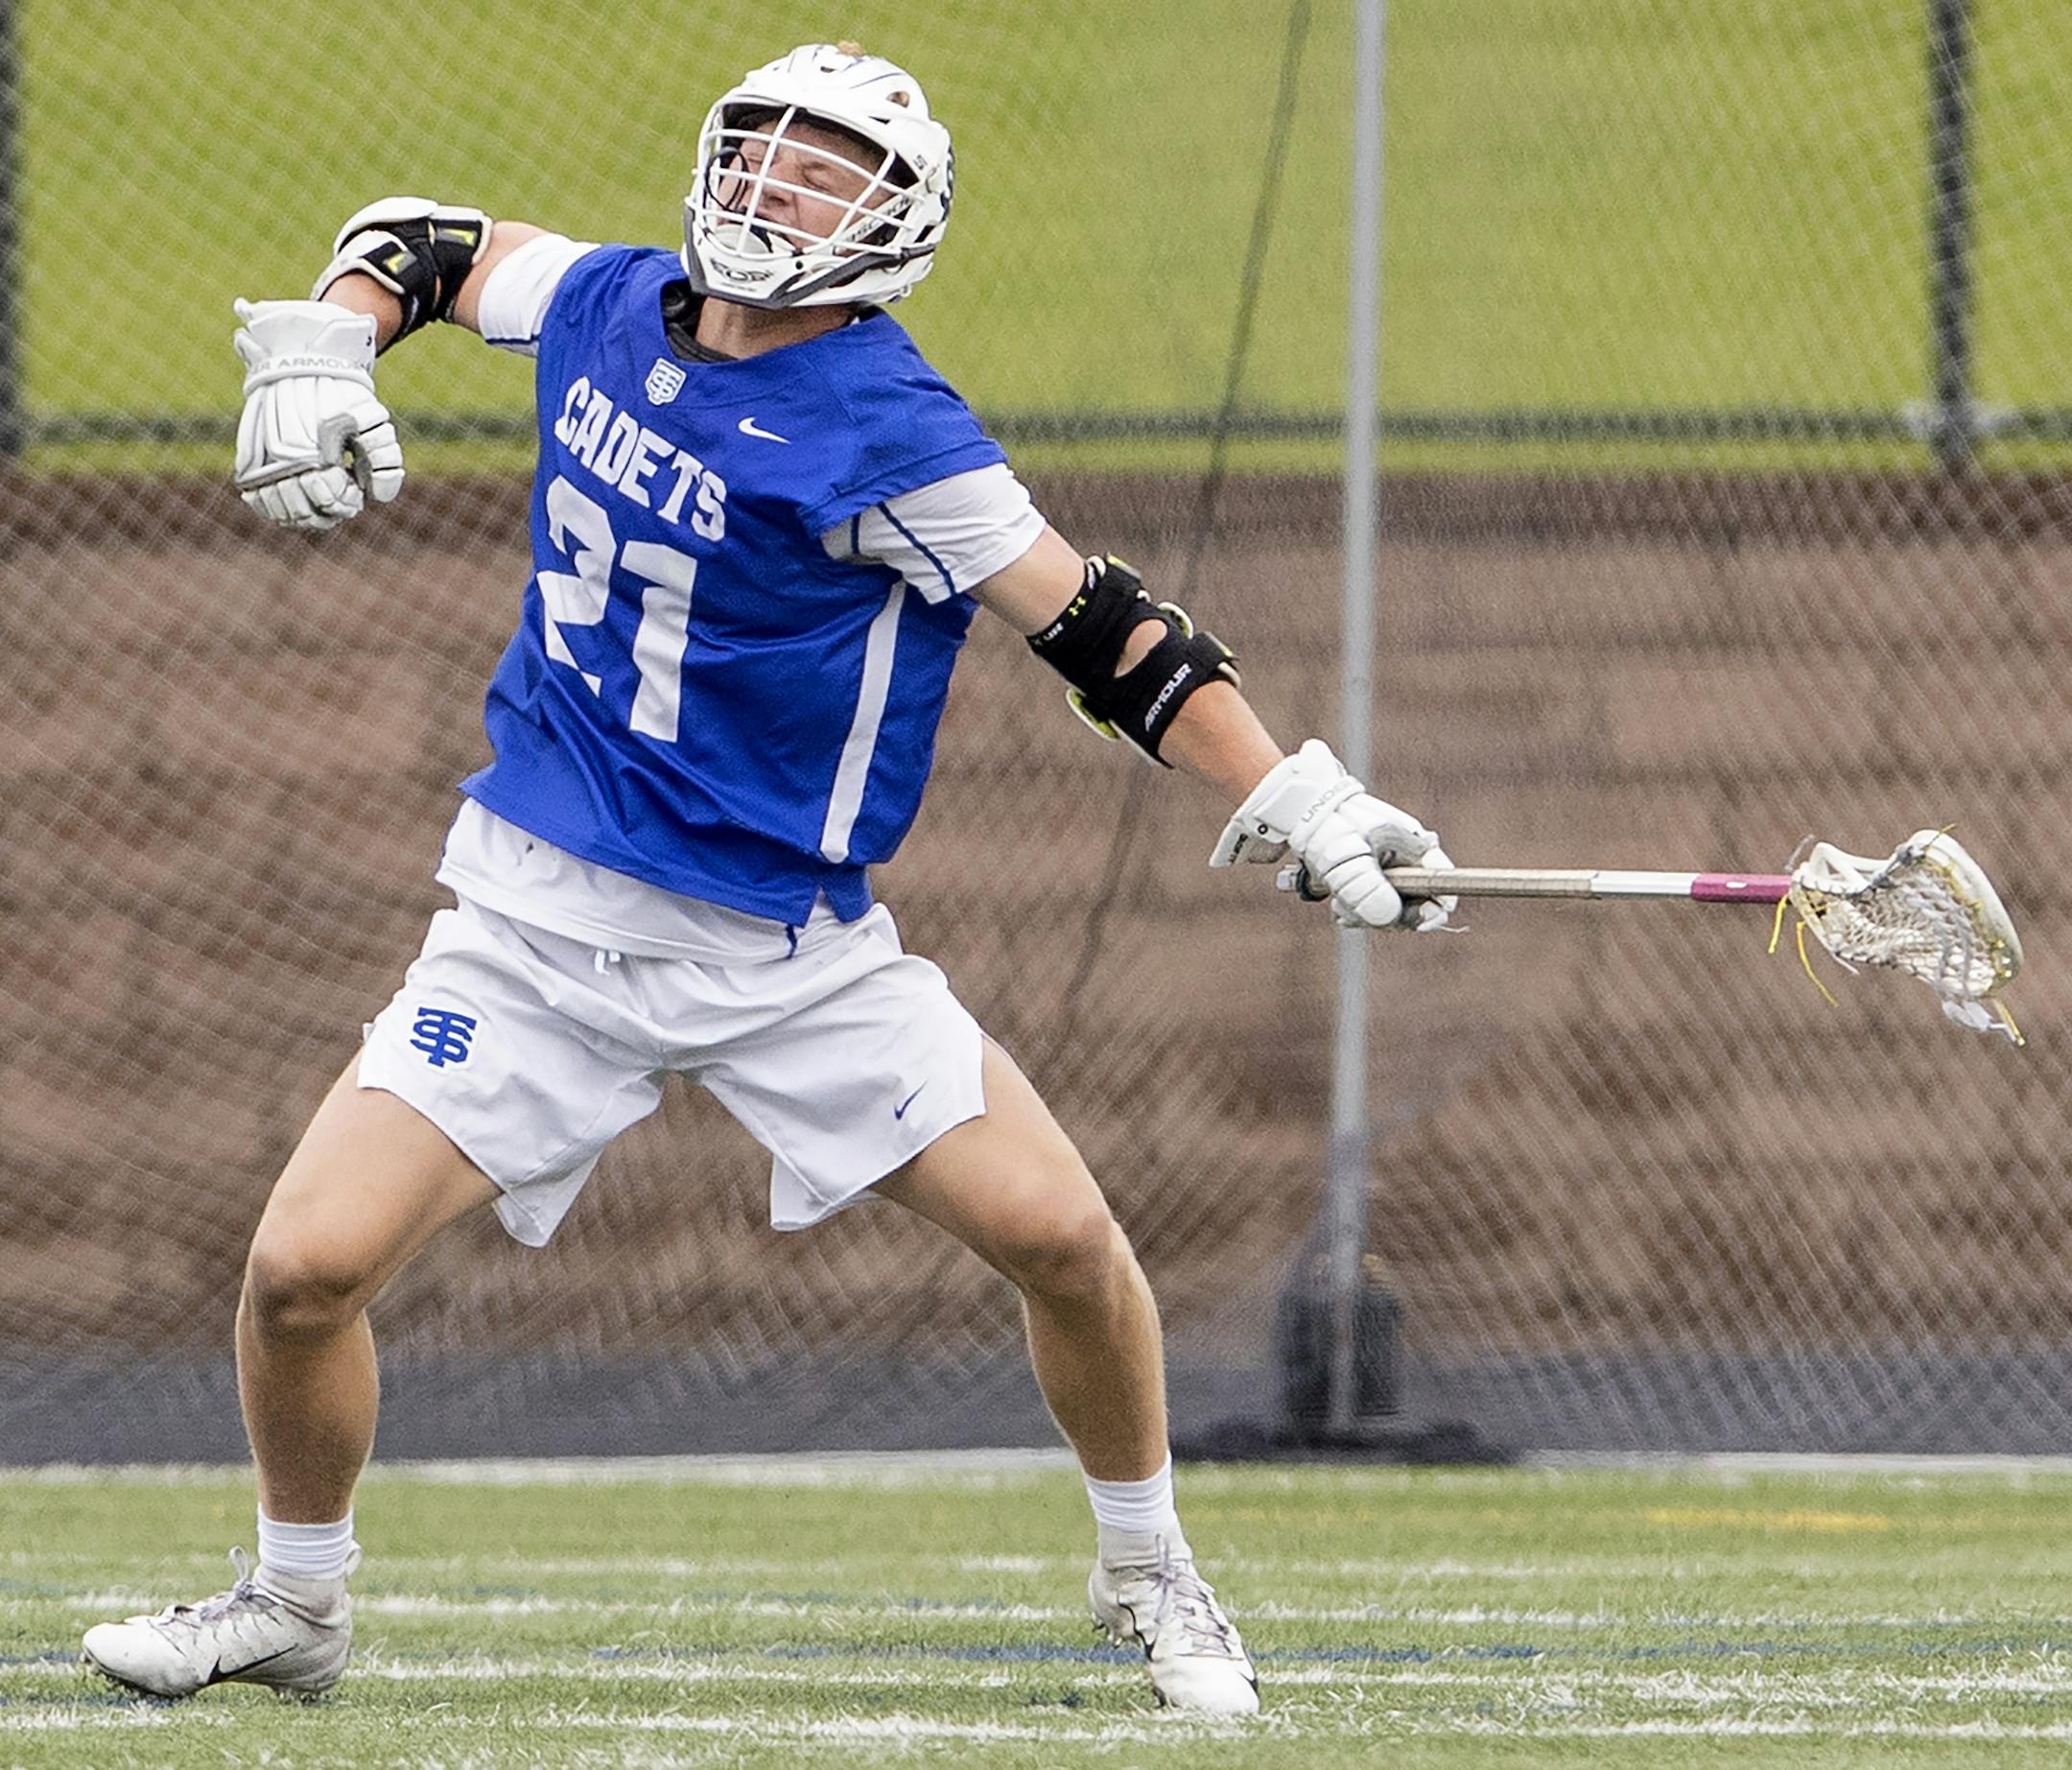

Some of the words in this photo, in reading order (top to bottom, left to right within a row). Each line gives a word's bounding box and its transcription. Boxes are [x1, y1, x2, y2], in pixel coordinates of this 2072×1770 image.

[553, 376, 727, 542] CADETS
[536, 474, 698, 743] 21
[1143, 662, 1192, 733] ARMOUR
